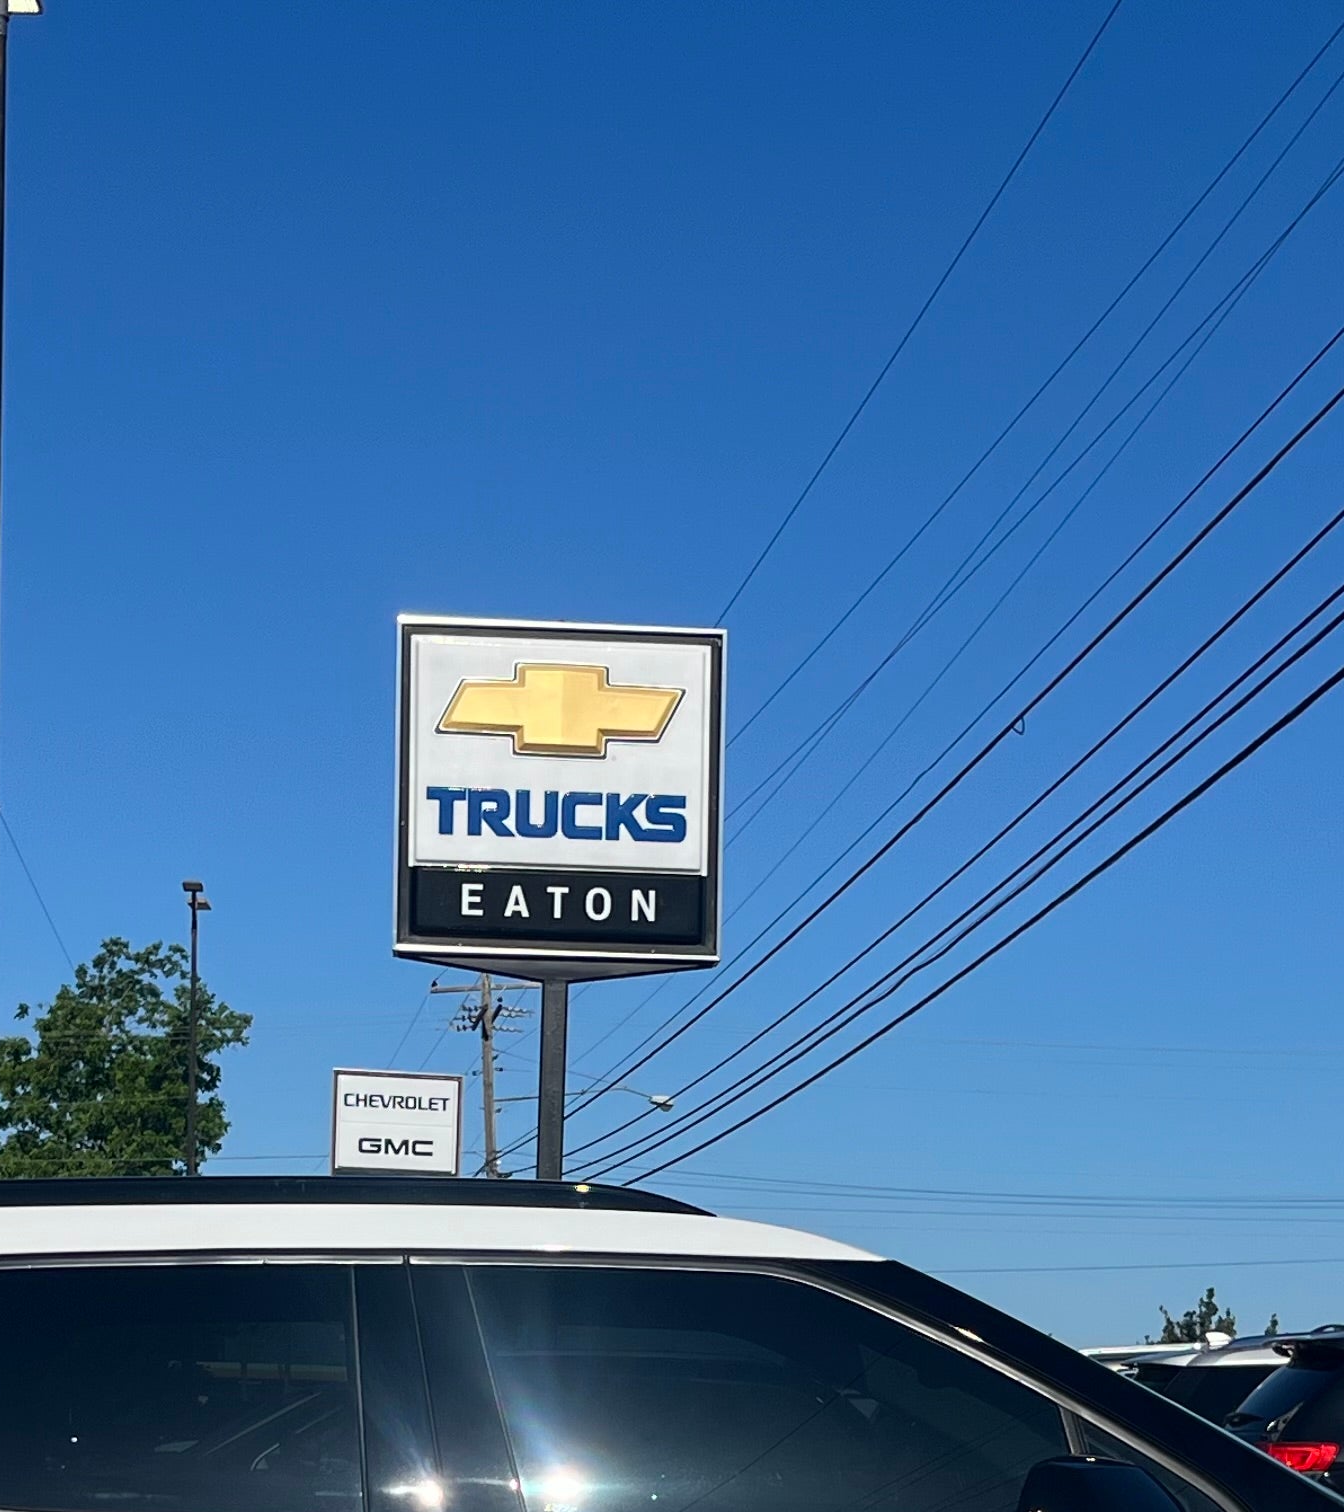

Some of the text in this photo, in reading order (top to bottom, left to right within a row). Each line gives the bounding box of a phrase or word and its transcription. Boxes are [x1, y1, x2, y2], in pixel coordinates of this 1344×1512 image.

[426, 786, 687, 842] TRUCKS
[461, 883, 656, 922] EATON
[343, 1093, 451, 1112] CHEVROLET
[358, 1137, 434, 1157] GMC
